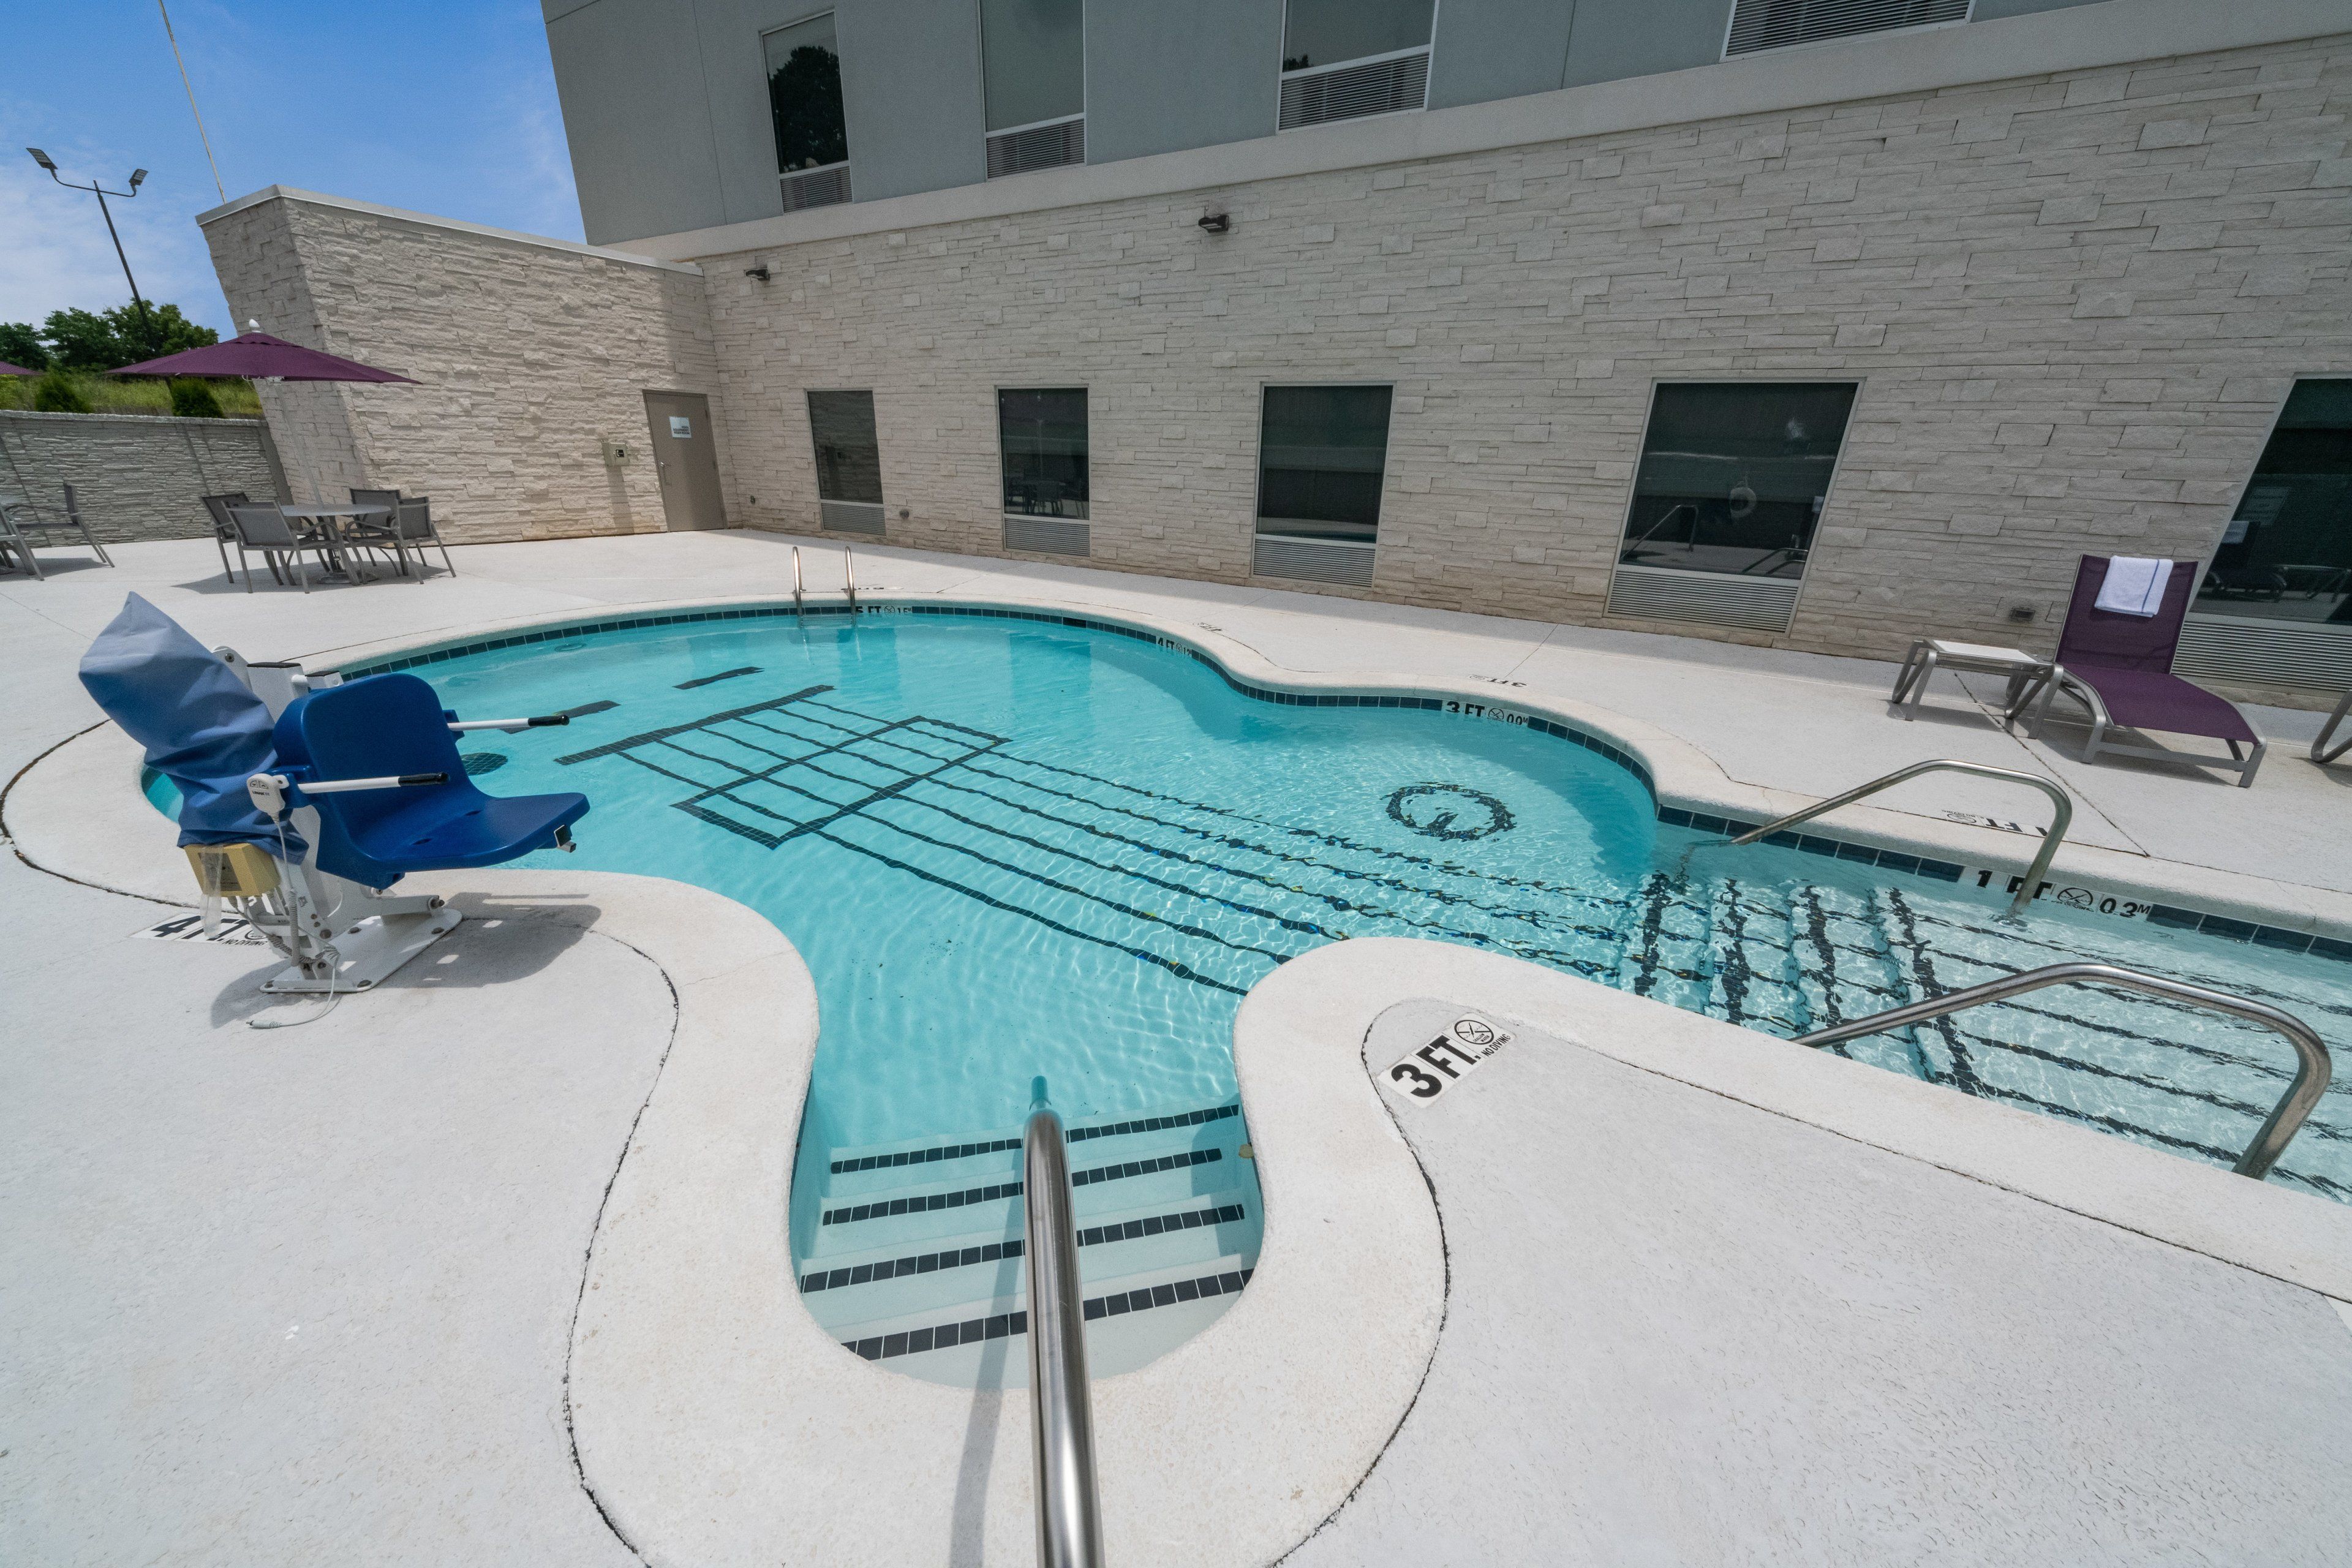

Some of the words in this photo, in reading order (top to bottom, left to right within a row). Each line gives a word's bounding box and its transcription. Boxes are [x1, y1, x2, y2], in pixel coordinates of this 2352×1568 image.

[1158, 637, 1164, 646] 4
[1446, 701, 1460, 713] 3
[1977, 870, 1993, 888] 1
[151, 915, 203, 938] 4
[1481, 1047, 1494, 1057] NO
[1489, 1033, 1511, 1050] DIVING
[1391, 1063, 1442, 1098] 3
